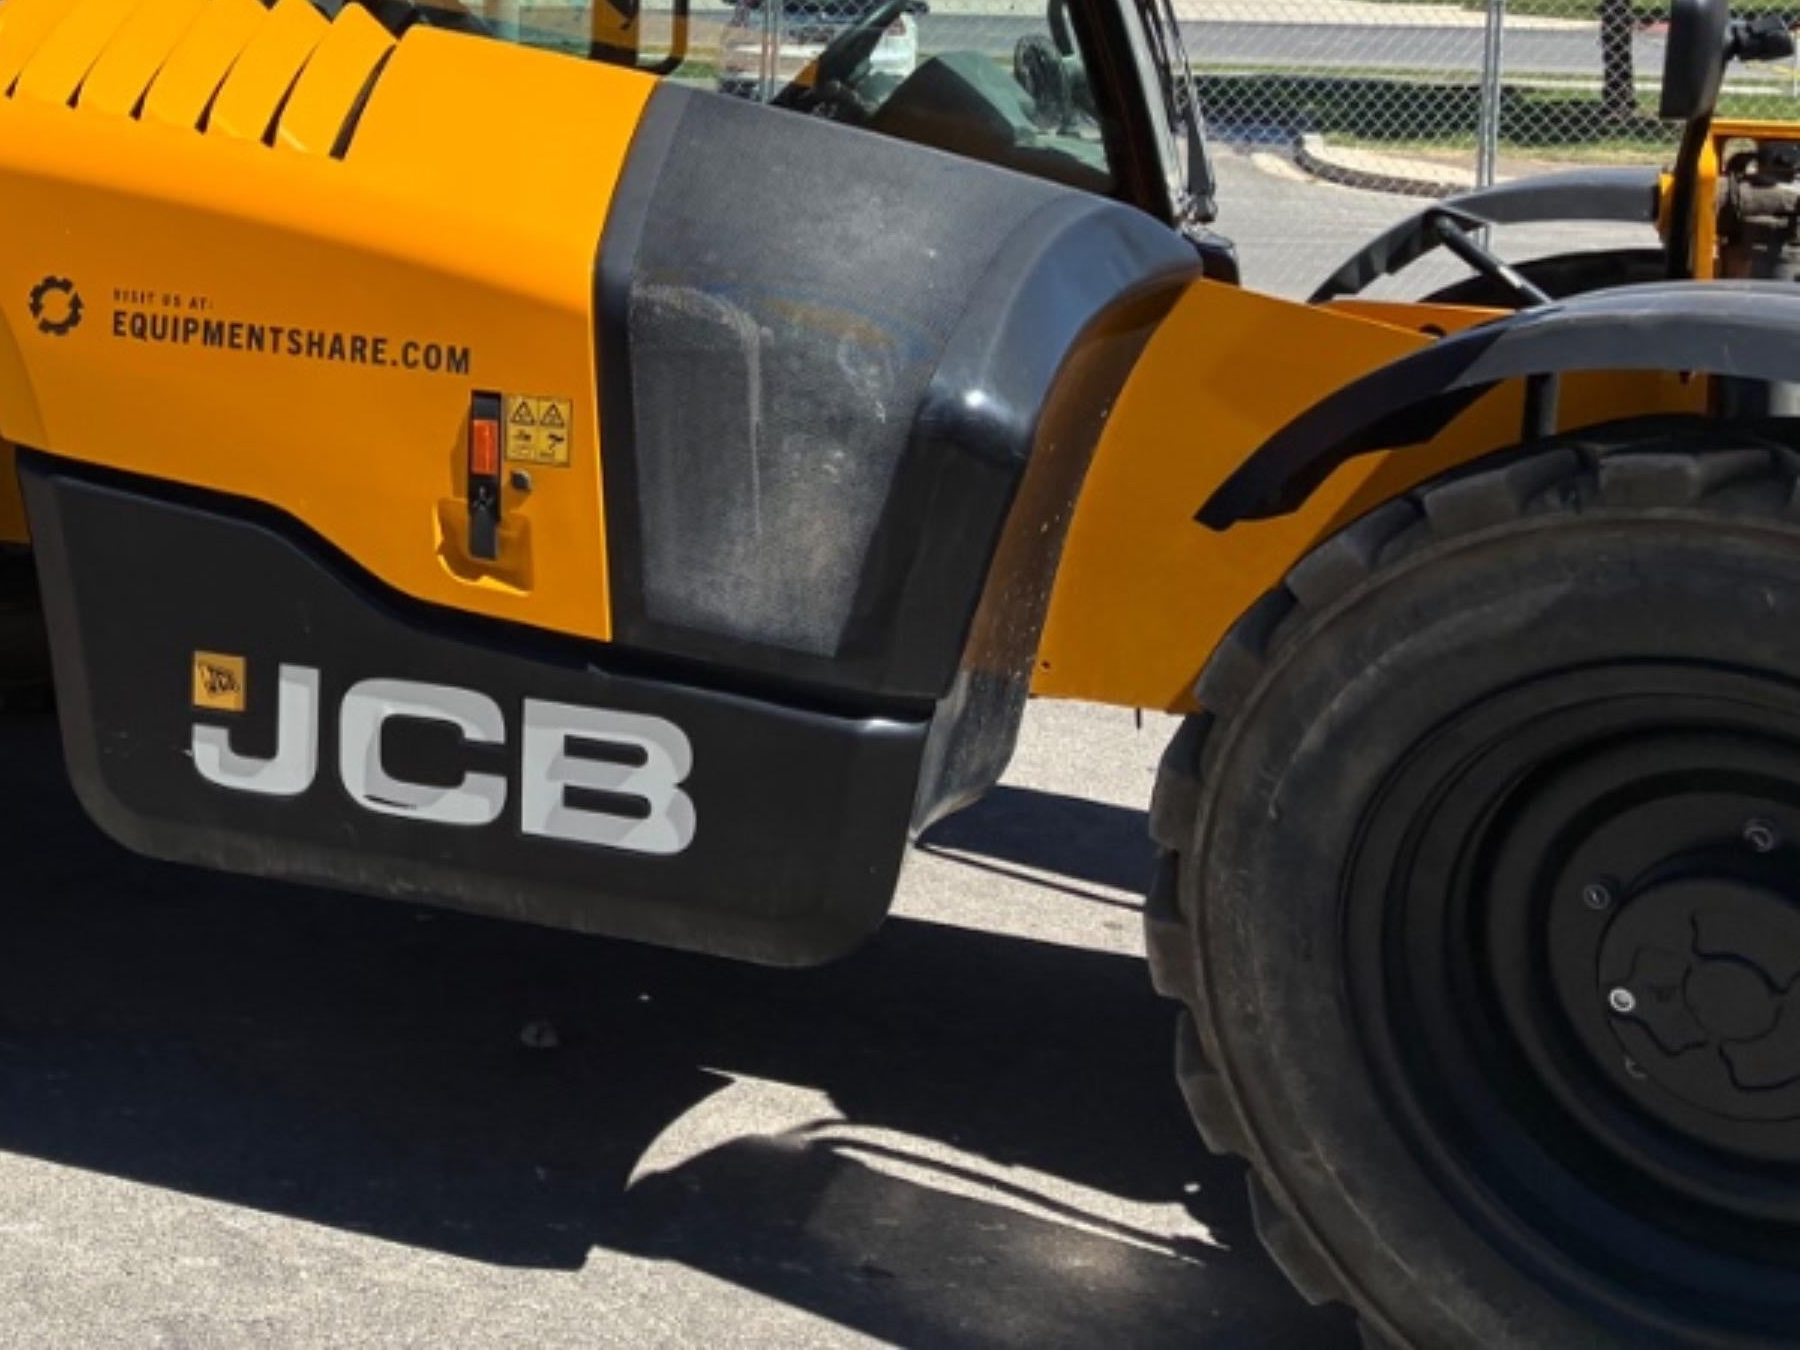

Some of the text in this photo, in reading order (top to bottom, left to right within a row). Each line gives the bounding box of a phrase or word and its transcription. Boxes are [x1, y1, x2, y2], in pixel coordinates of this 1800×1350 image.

[113, 287, 154, 305] VISIT
[162, 293, 181, 307] US
[112, 310, 471, 374] EQUIPMENTSHARE.COM
[192, 662, 697, 856] JCB
